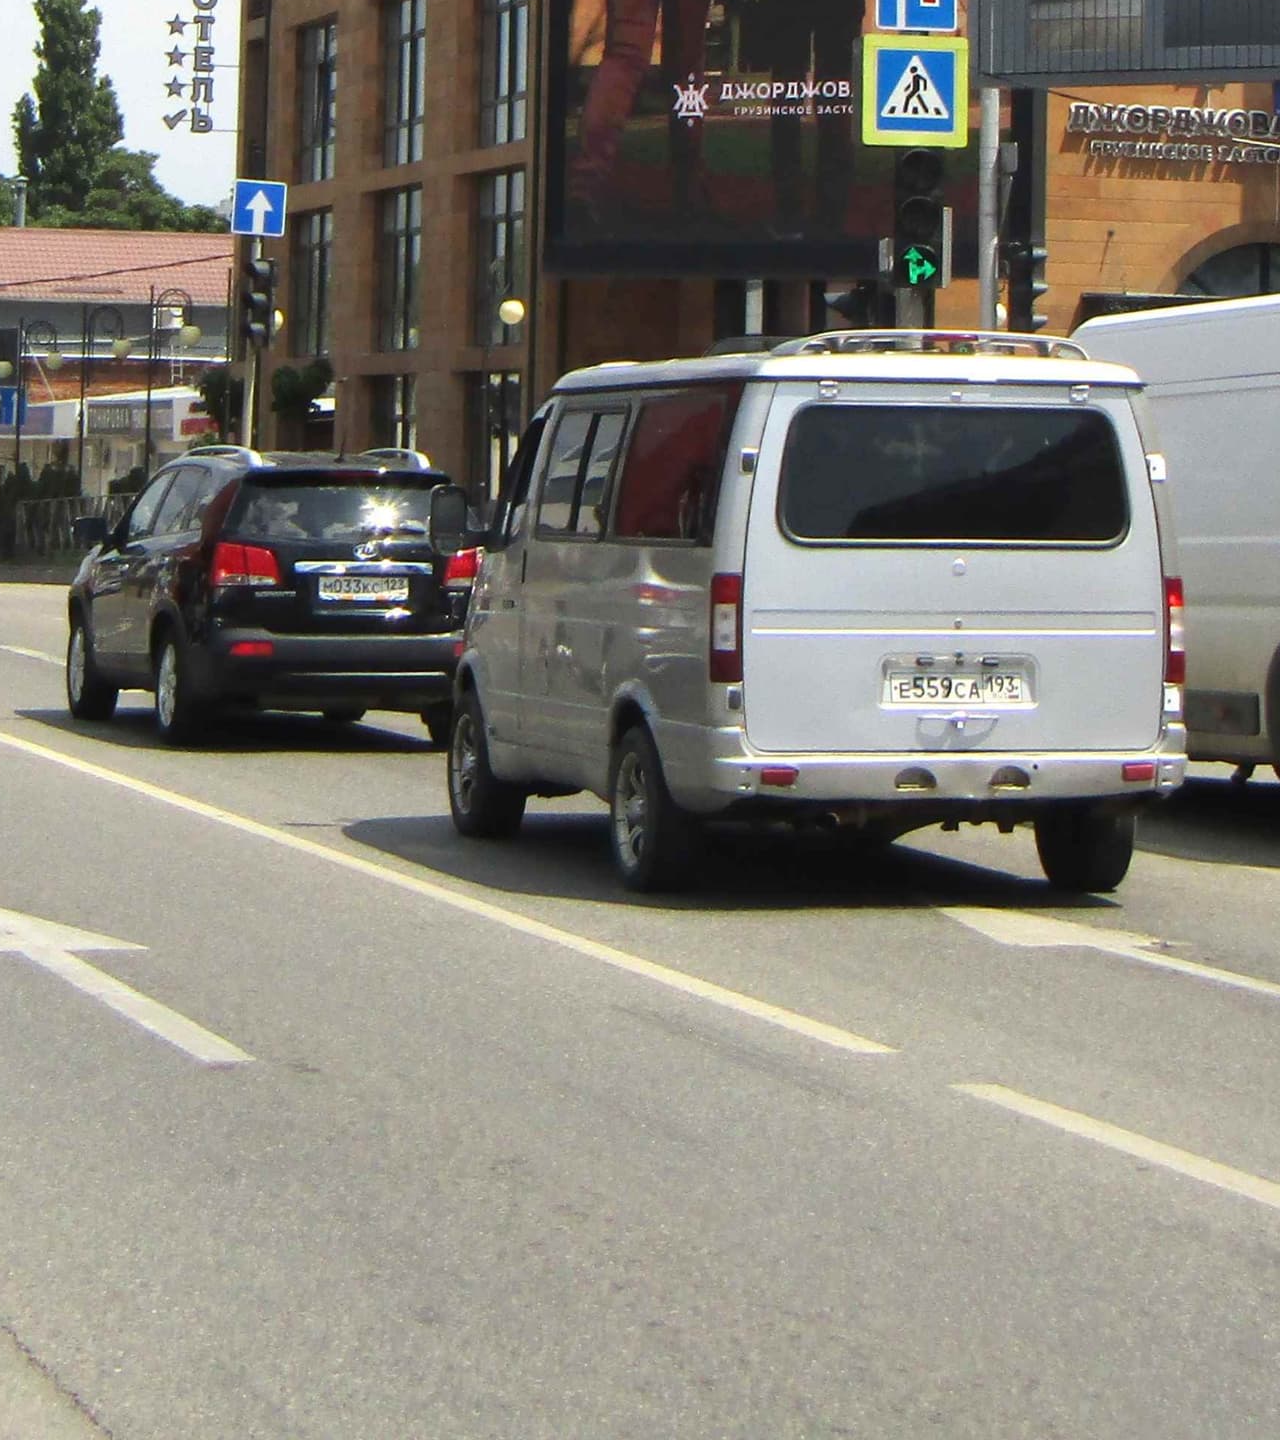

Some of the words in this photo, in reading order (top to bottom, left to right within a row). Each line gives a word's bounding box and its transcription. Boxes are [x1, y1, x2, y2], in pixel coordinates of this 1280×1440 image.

[720, 81, 854, 100] ДЖОРДЖОВ
[734, 106, 812, 116] ГРУЗИНСКОЕ
[898, 676, 980, 699] Е559СА
[985, 675, 1015, 693] 193
